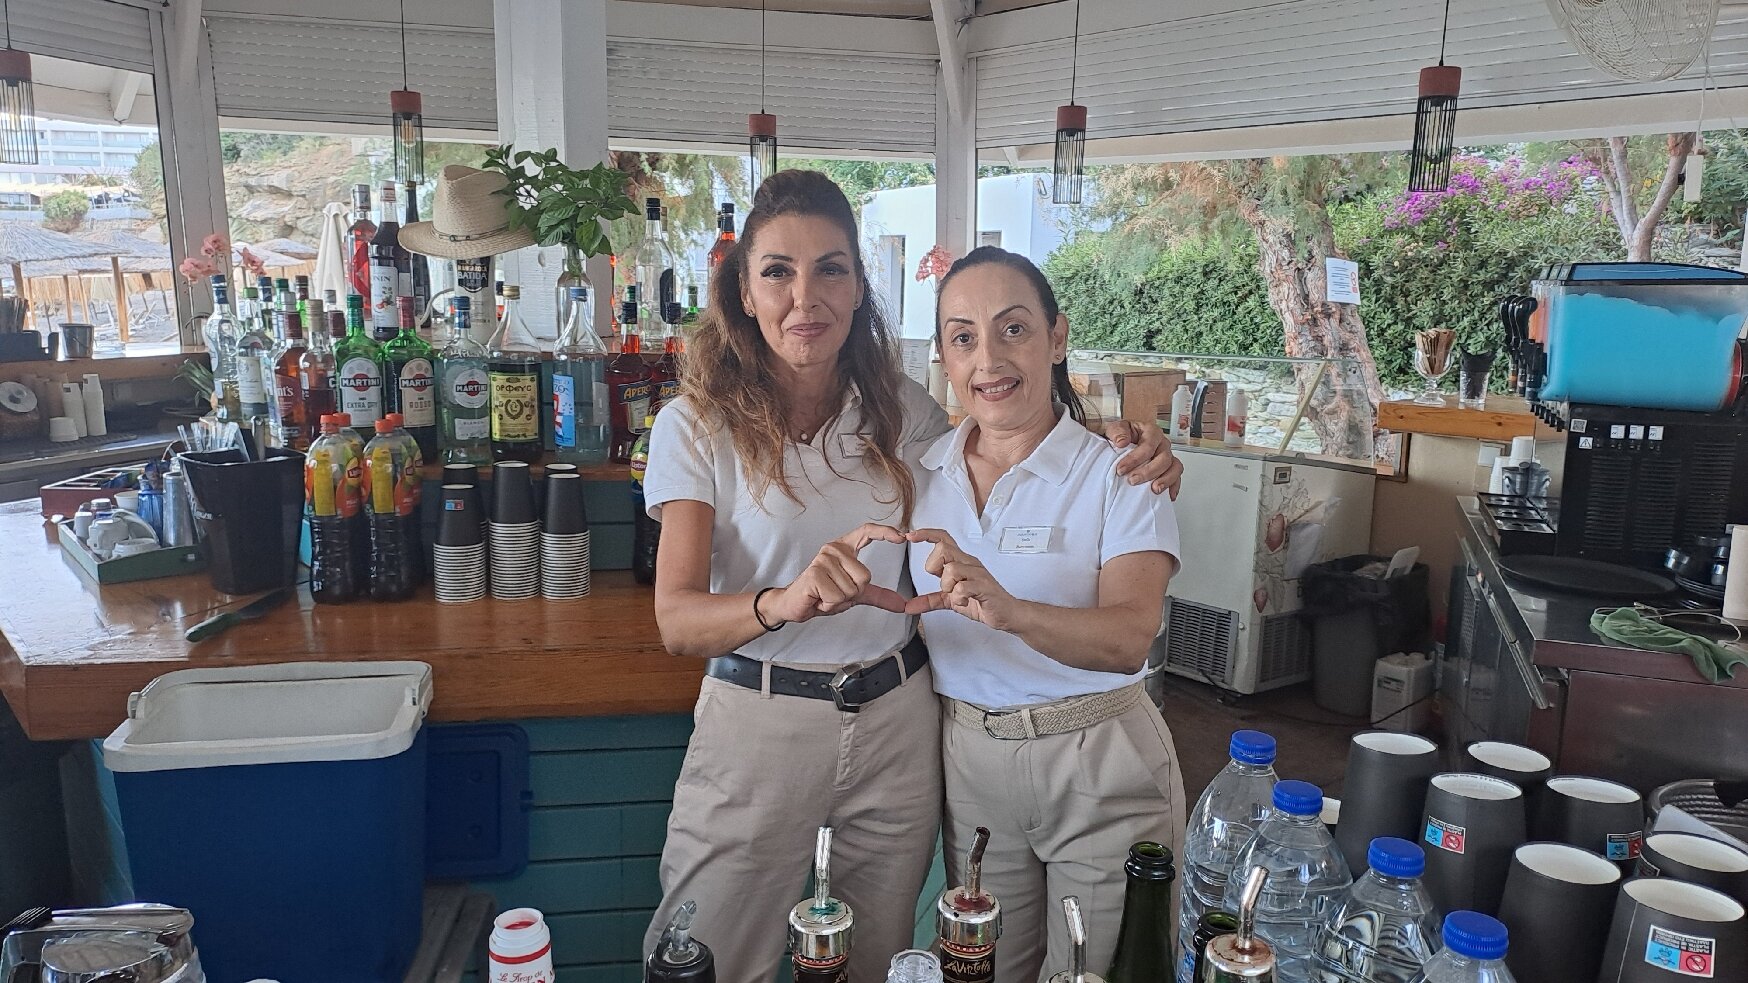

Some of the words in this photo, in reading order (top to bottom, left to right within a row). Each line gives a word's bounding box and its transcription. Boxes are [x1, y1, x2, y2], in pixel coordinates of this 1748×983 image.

[457, 271, 488, 280] BATIDA
[342, 378, 380, 387] MARTINI
[277, 386, 294, 397] nt's
[623, 384, 651, 400] APERO
[346, 401, 366, 409] EXTRA
